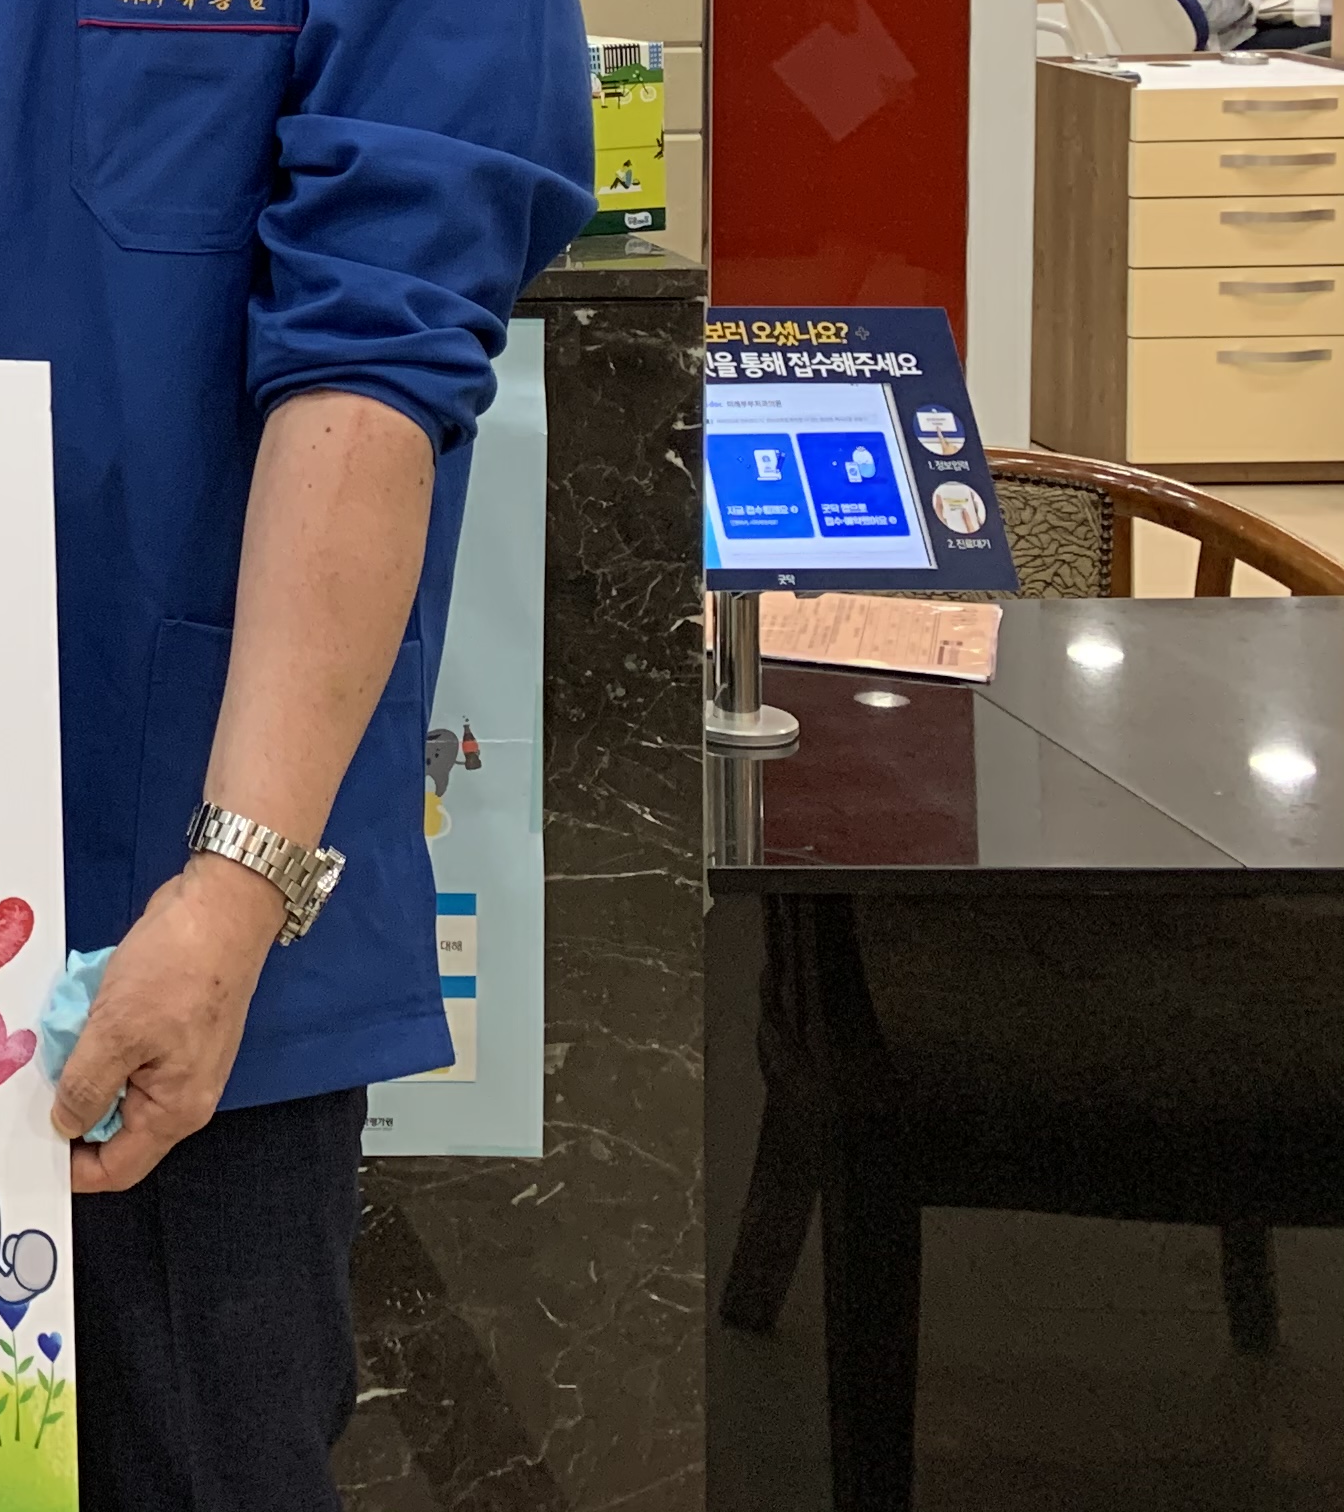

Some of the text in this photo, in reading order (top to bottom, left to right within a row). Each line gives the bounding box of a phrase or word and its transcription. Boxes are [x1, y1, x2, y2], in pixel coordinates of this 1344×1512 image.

[705, 320, 849, 346] 보러 오셨나요?
[740, 351, 787, 379] 통해
[787, 351, 923, 378] 접수해주세요
